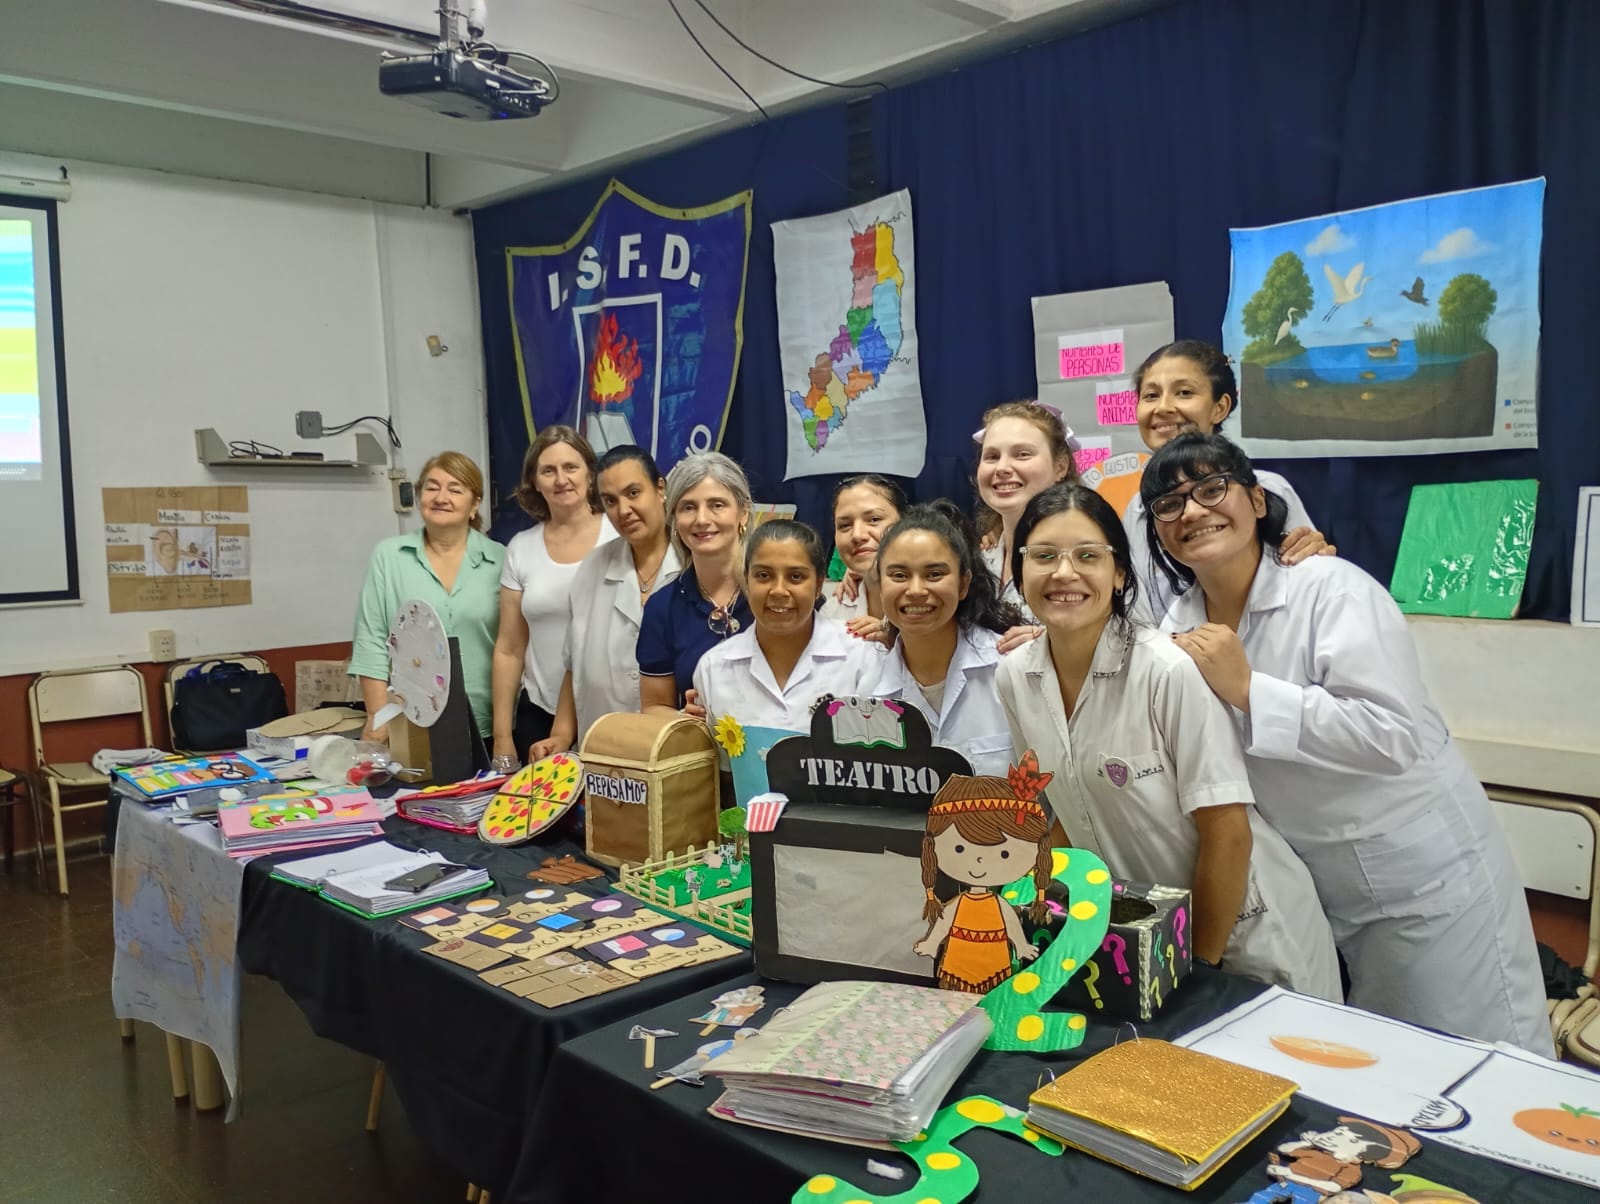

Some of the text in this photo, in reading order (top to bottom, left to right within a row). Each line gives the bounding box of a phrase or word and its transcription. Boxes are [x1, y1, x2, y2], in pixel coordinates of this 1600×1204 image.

[1066, 356, 1119, 377] PERSONAS
[1104, 456, 1139, 476] GUSTO
[800, 757, 941, 795] TEATRO
